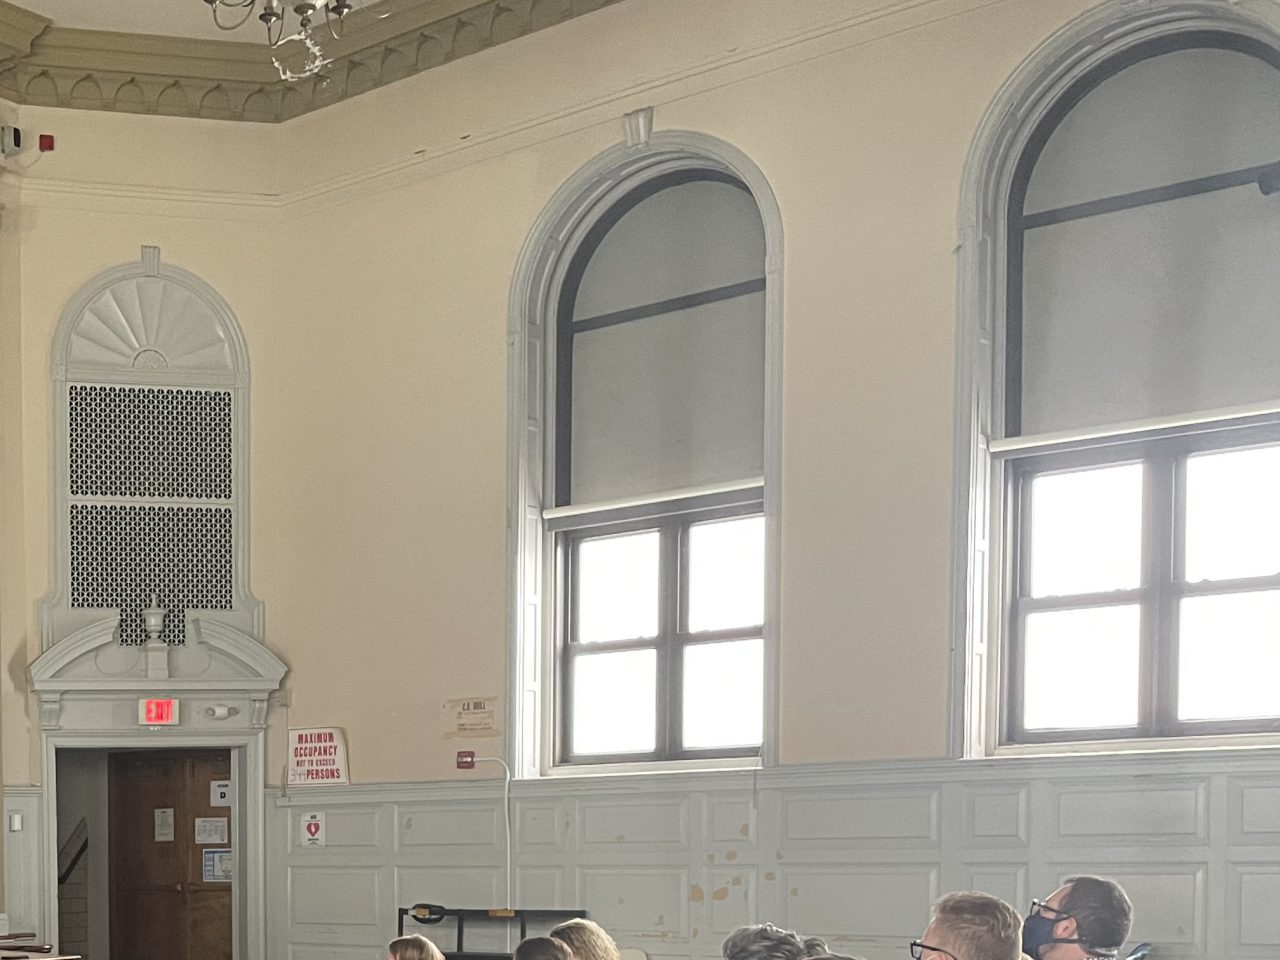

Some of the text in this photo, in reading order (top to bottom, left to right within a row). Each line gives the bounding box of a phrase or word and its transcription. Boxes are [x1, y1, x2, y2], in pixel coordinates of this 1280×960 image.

[145, 699, 173, 723] EXIT
[297, 732, 335, 744] MAXIMUM
[294, 745, 338, 758] OCCUPANCY
[296, 758, 336, 767] NOT TO EXCEED
[306, 768, 341, 780] PERSONS
